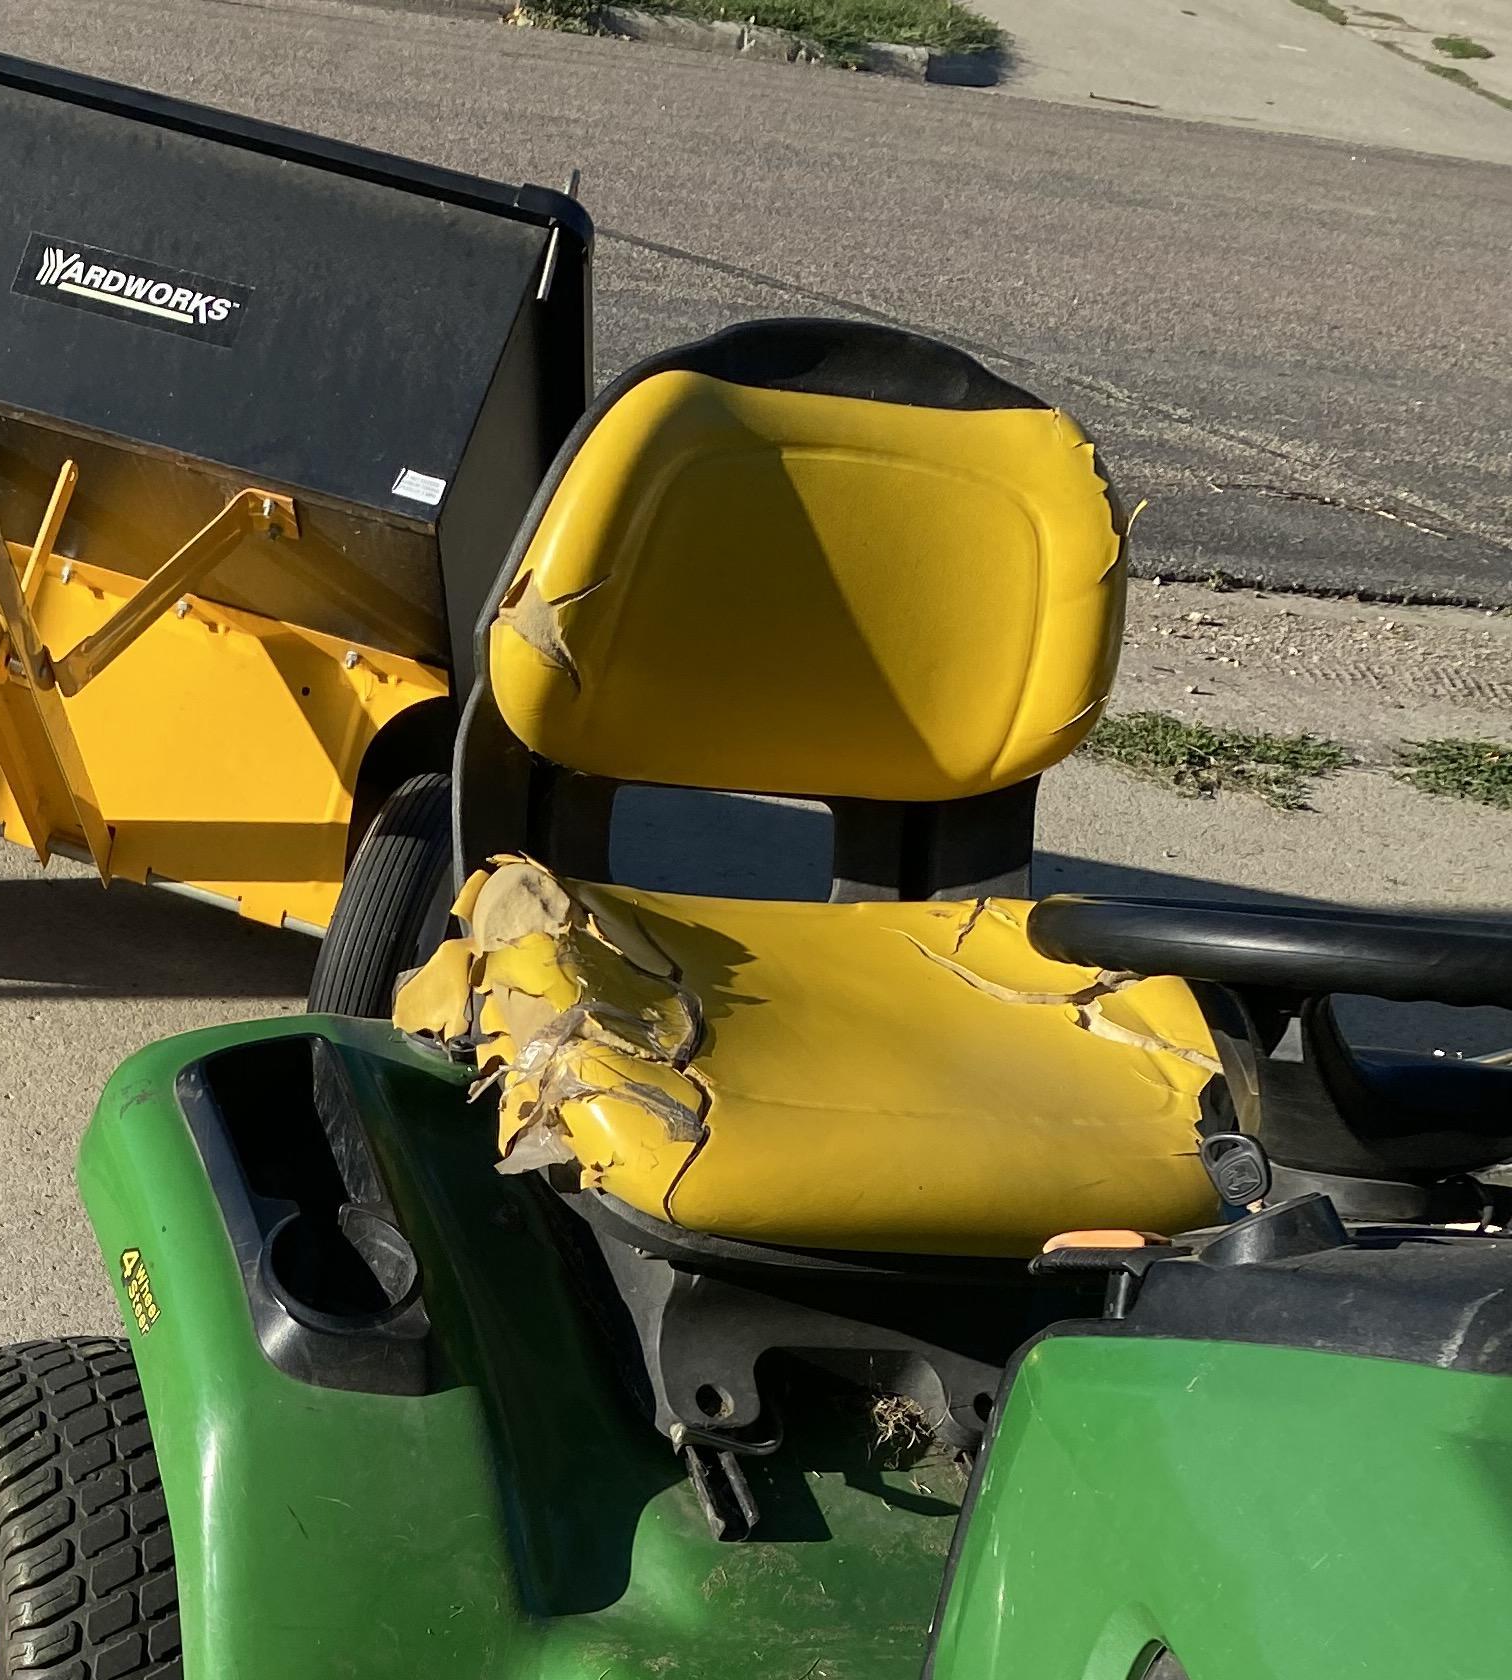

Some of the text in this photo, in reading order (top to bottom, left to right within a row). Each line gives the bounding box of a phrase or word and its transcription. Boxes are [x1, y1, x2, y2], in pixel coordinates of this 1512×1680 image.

[36, 247, 231, 324] YARDWORKS
[121, 1249, 161, 1324] 4 Wheel
